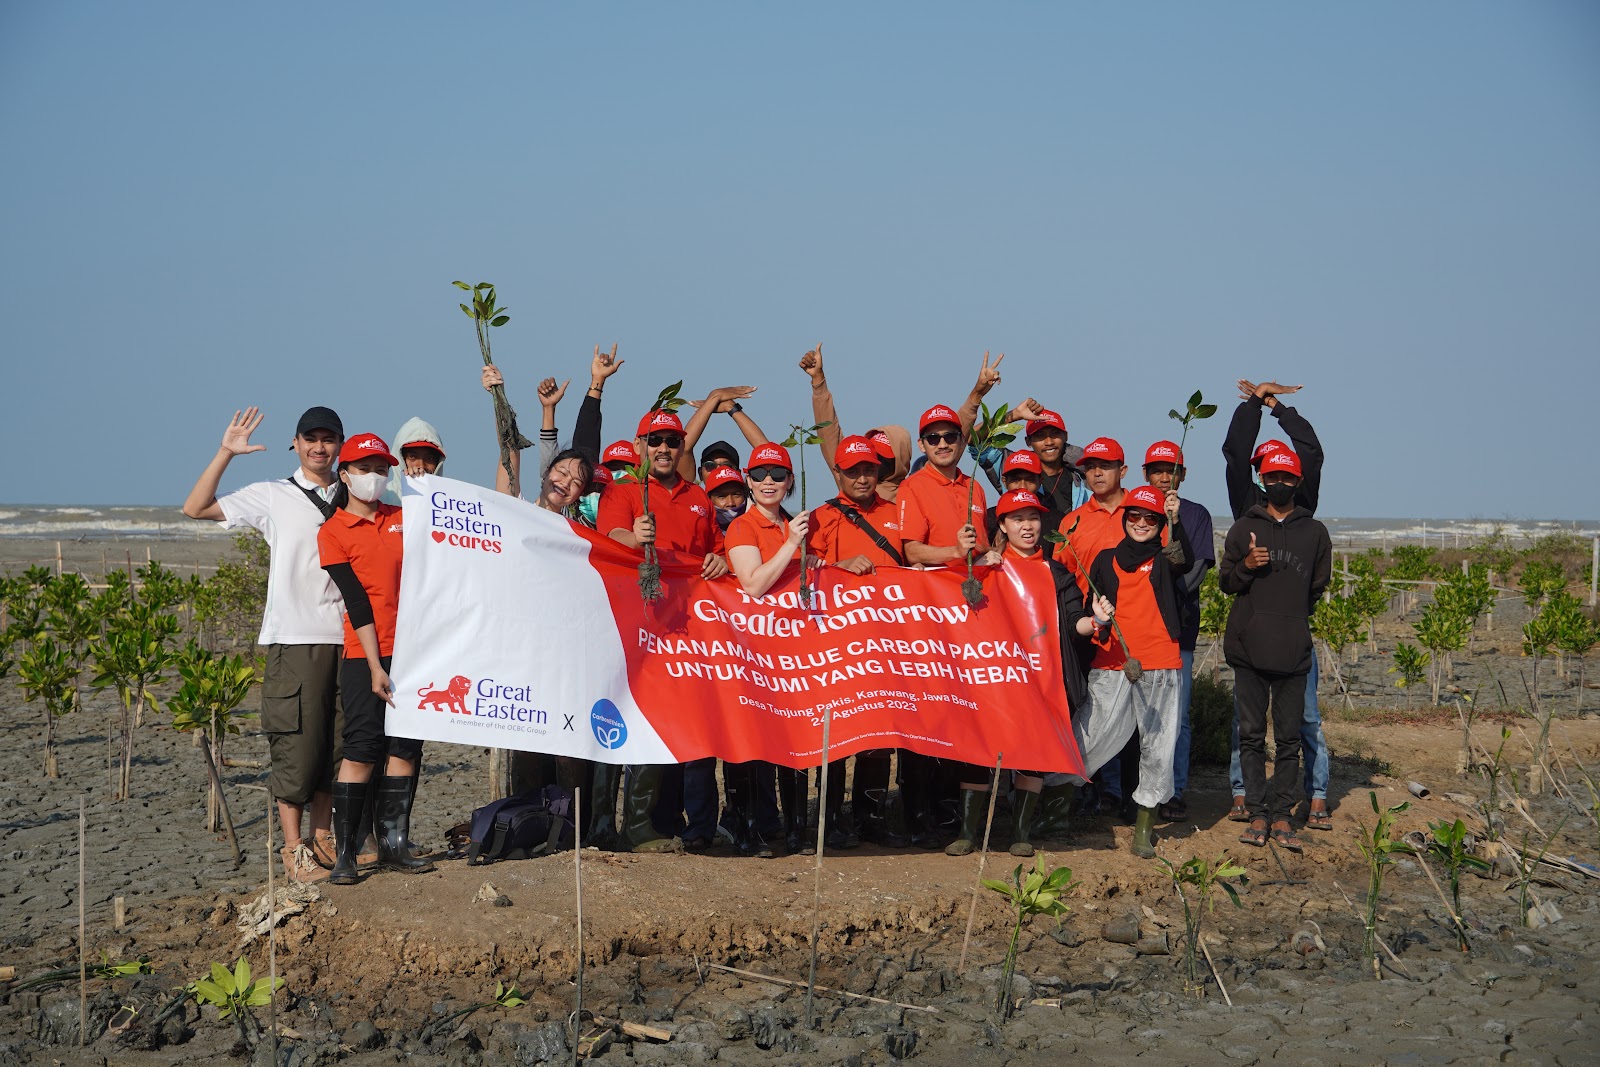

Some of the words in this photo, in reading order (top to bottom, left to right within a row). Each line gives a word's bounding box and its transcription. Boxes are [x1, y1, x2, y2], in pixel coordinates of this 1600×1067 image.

[431, 491, 484, 517] Great
[431, 509, 502, 537] Eastern
[448, 534, 502, 554] cares
[832, 583, 876, 608] for
[883, 584, 906, 602] a
[693, 599, 806, 638] Greater
[808, 603, 969, 634] Tomorrow
[638, 627, 775, 670] PENANAMAN
[777, 647, 843, 671] BLUE
[846, 637, 947, 657] CARBON
[949, 640, 1042, 673] PACKAE
[665, 661, 750, 682] UNTUK
[751, 669, 810, 693] BUMI
[812, 659, 884, 688] YANG
[888, 658, 955, 680] LEBIH
[956, 665, 1029, 684] HEBAT
[477, 678, 532, 703] Great
[738, 695, 766, 711] Desa
[767, 703, 815, 718] Tanjung
[816, 697, 855, 713] Pakis,
[856, 689, 920, 702] Karawang,
[922, 691, 950, 702] Jawa
[950, 694, 979, 711] Barat
[474, 698, 547, 724] Eastern
[832, 700, 885, 720] Agustus
[886, 699, 918, 712] 2023
[457, 719, 484, 728] member
[495, 722, 505, 730] the
[507, 724, 525, 732] OCBC
[526, 726, 547, 735] Group
